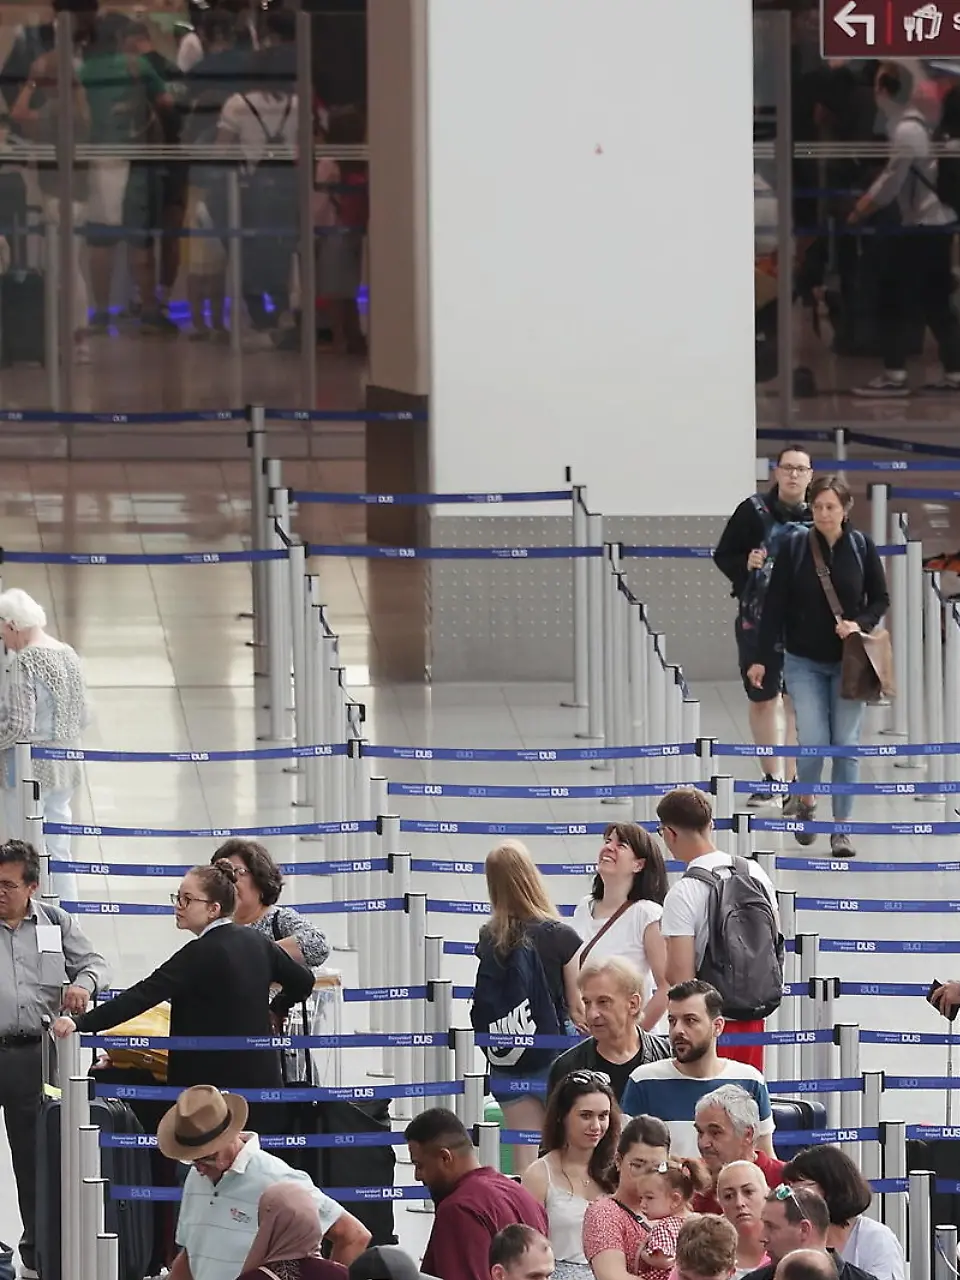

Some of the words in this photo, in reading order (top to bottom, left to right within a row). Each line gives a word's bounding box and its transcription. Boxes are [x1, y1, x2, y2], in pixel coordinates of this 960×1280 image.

[316, 746, 332, 754] DUS
[662, 746, 680, 755] DUS
[756, 747, 774, 756] DUS
[880, 746, 896, 754] DUS
[66, 751, 84, 760] DUS
[192, 753, 209, 761] DUS
[415, 750, 433, 759] DUS
[539, 751, 557, 760] DUS
[424, 786, 442, 794] DUS
[551, 788, 569, 797] DUS
[771, 784, 789, 793] DUS
[897, 784, 915, 793] DUS
[341, 823, 359, 832] DUS
[440, 824, 458, 832] DUS
[570, 826, 586, 834] DUS
[786, 822, 804, 830] DUS
[914, 824, 932, 834] DUS
[84, 827, 101, 835] DUS
[91, 865, 109, 874] DUS
[354, 862, 370, 870] DUS
[454, 863, 473, 873] DUS
[586, 864, 598, 873] DU
[831, 862, 849, 870] DUS
[101, 904, 120, 913] DUS
[368, 901, 385, 909] DUS
[473, 904, 491, 913] DUS
[840, 901, 858, 910] DUS
[858, 942, 876, 950] DUS
[390, 989, 408, 997] DUS
[414, 1036, 432, 1044] DUS
[515, 1037, 533, 1045] DUS
[797, 1033, 815, 1041] DUS
[901, 1034, 920, 1044] DUS
[130, 1038, 149, 1046] DUS
[273, 1038, 290, 1046] DUS
[355, 1089, 373, 1097] DUS
[838, 1131, 857, 1139] DUS
[139, 1137, 157, 1145] DUS
[287, 1137, 305, 1145] DUS
[383, 1189, 402, 1197] DUS
